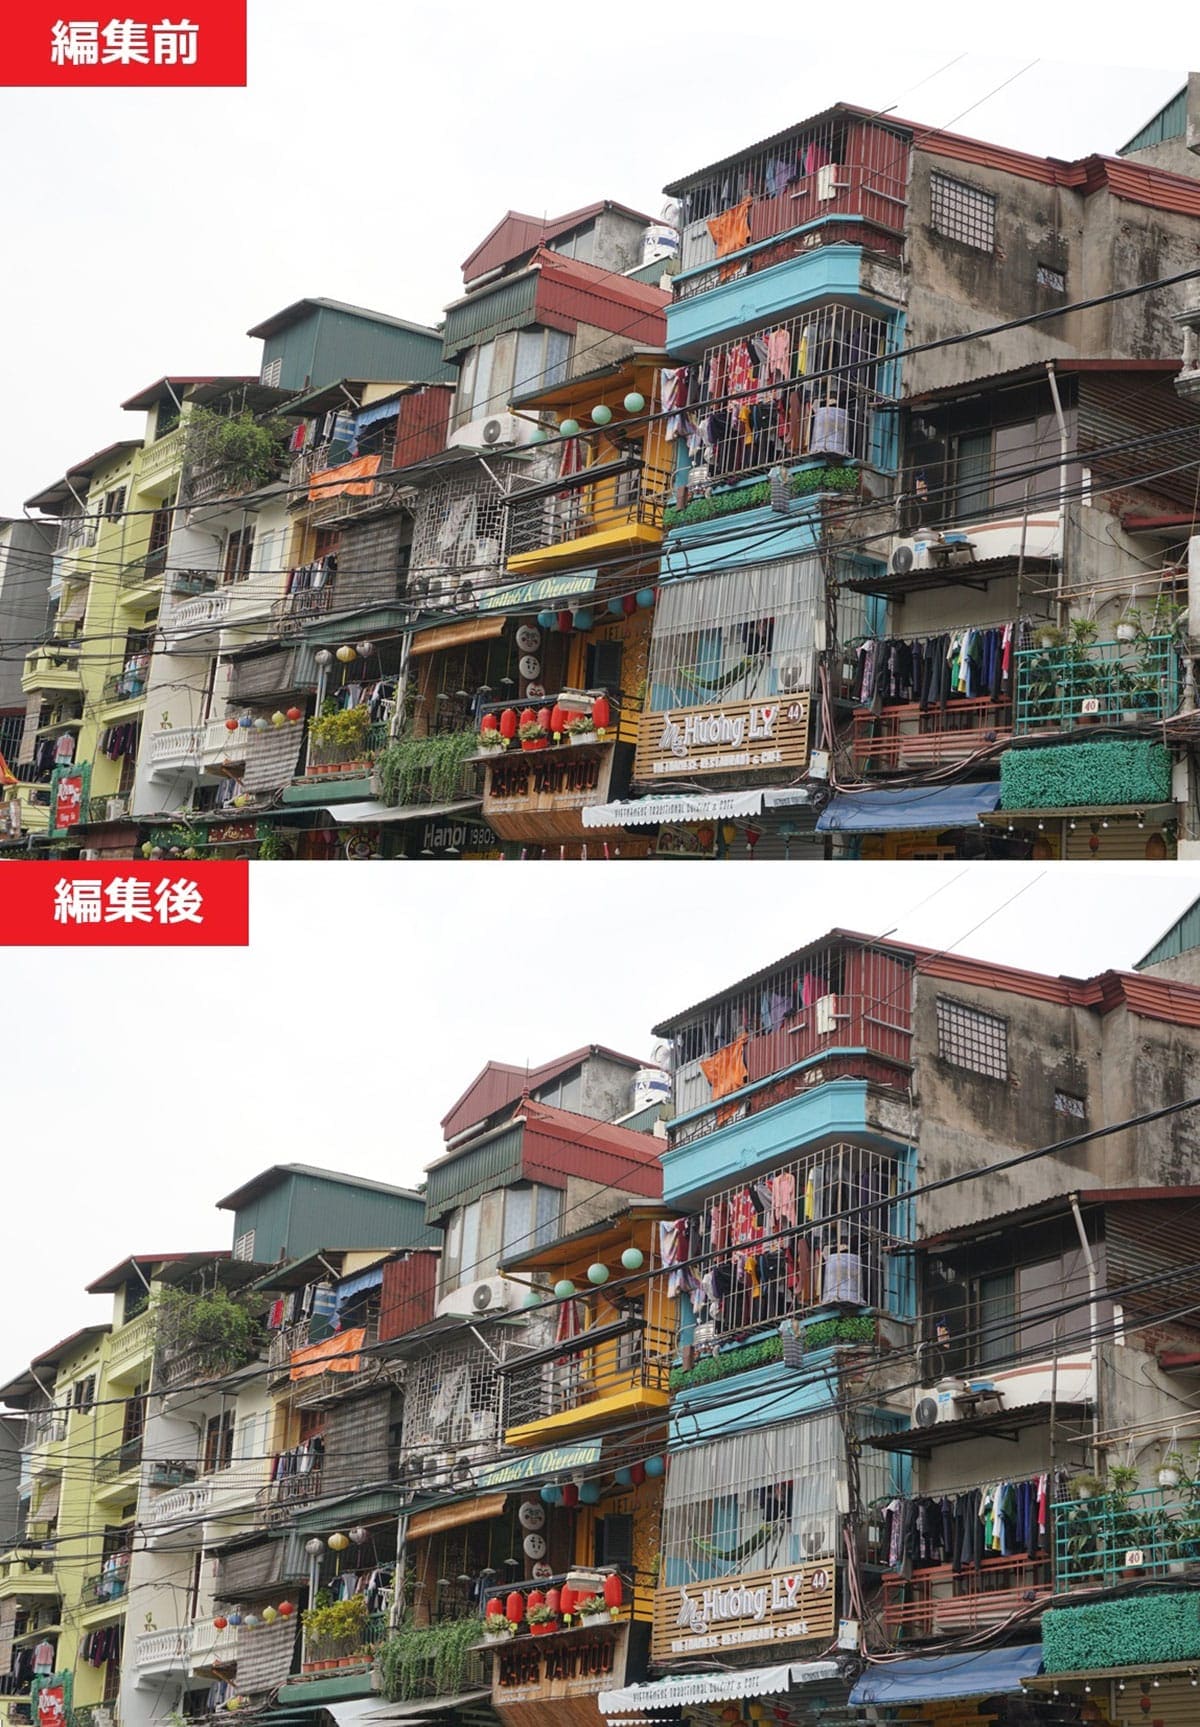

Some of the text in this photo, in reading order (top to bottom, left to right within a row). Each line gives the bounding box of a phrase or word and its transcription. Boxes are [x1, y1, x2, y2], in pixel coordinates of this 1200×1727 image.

[1085, 700, 1096, 711] 40
[787, 705, 800, 720] 44
[1129, 1552, 1140, 1564] 40
[812, 1573, 825, 1588] 44
